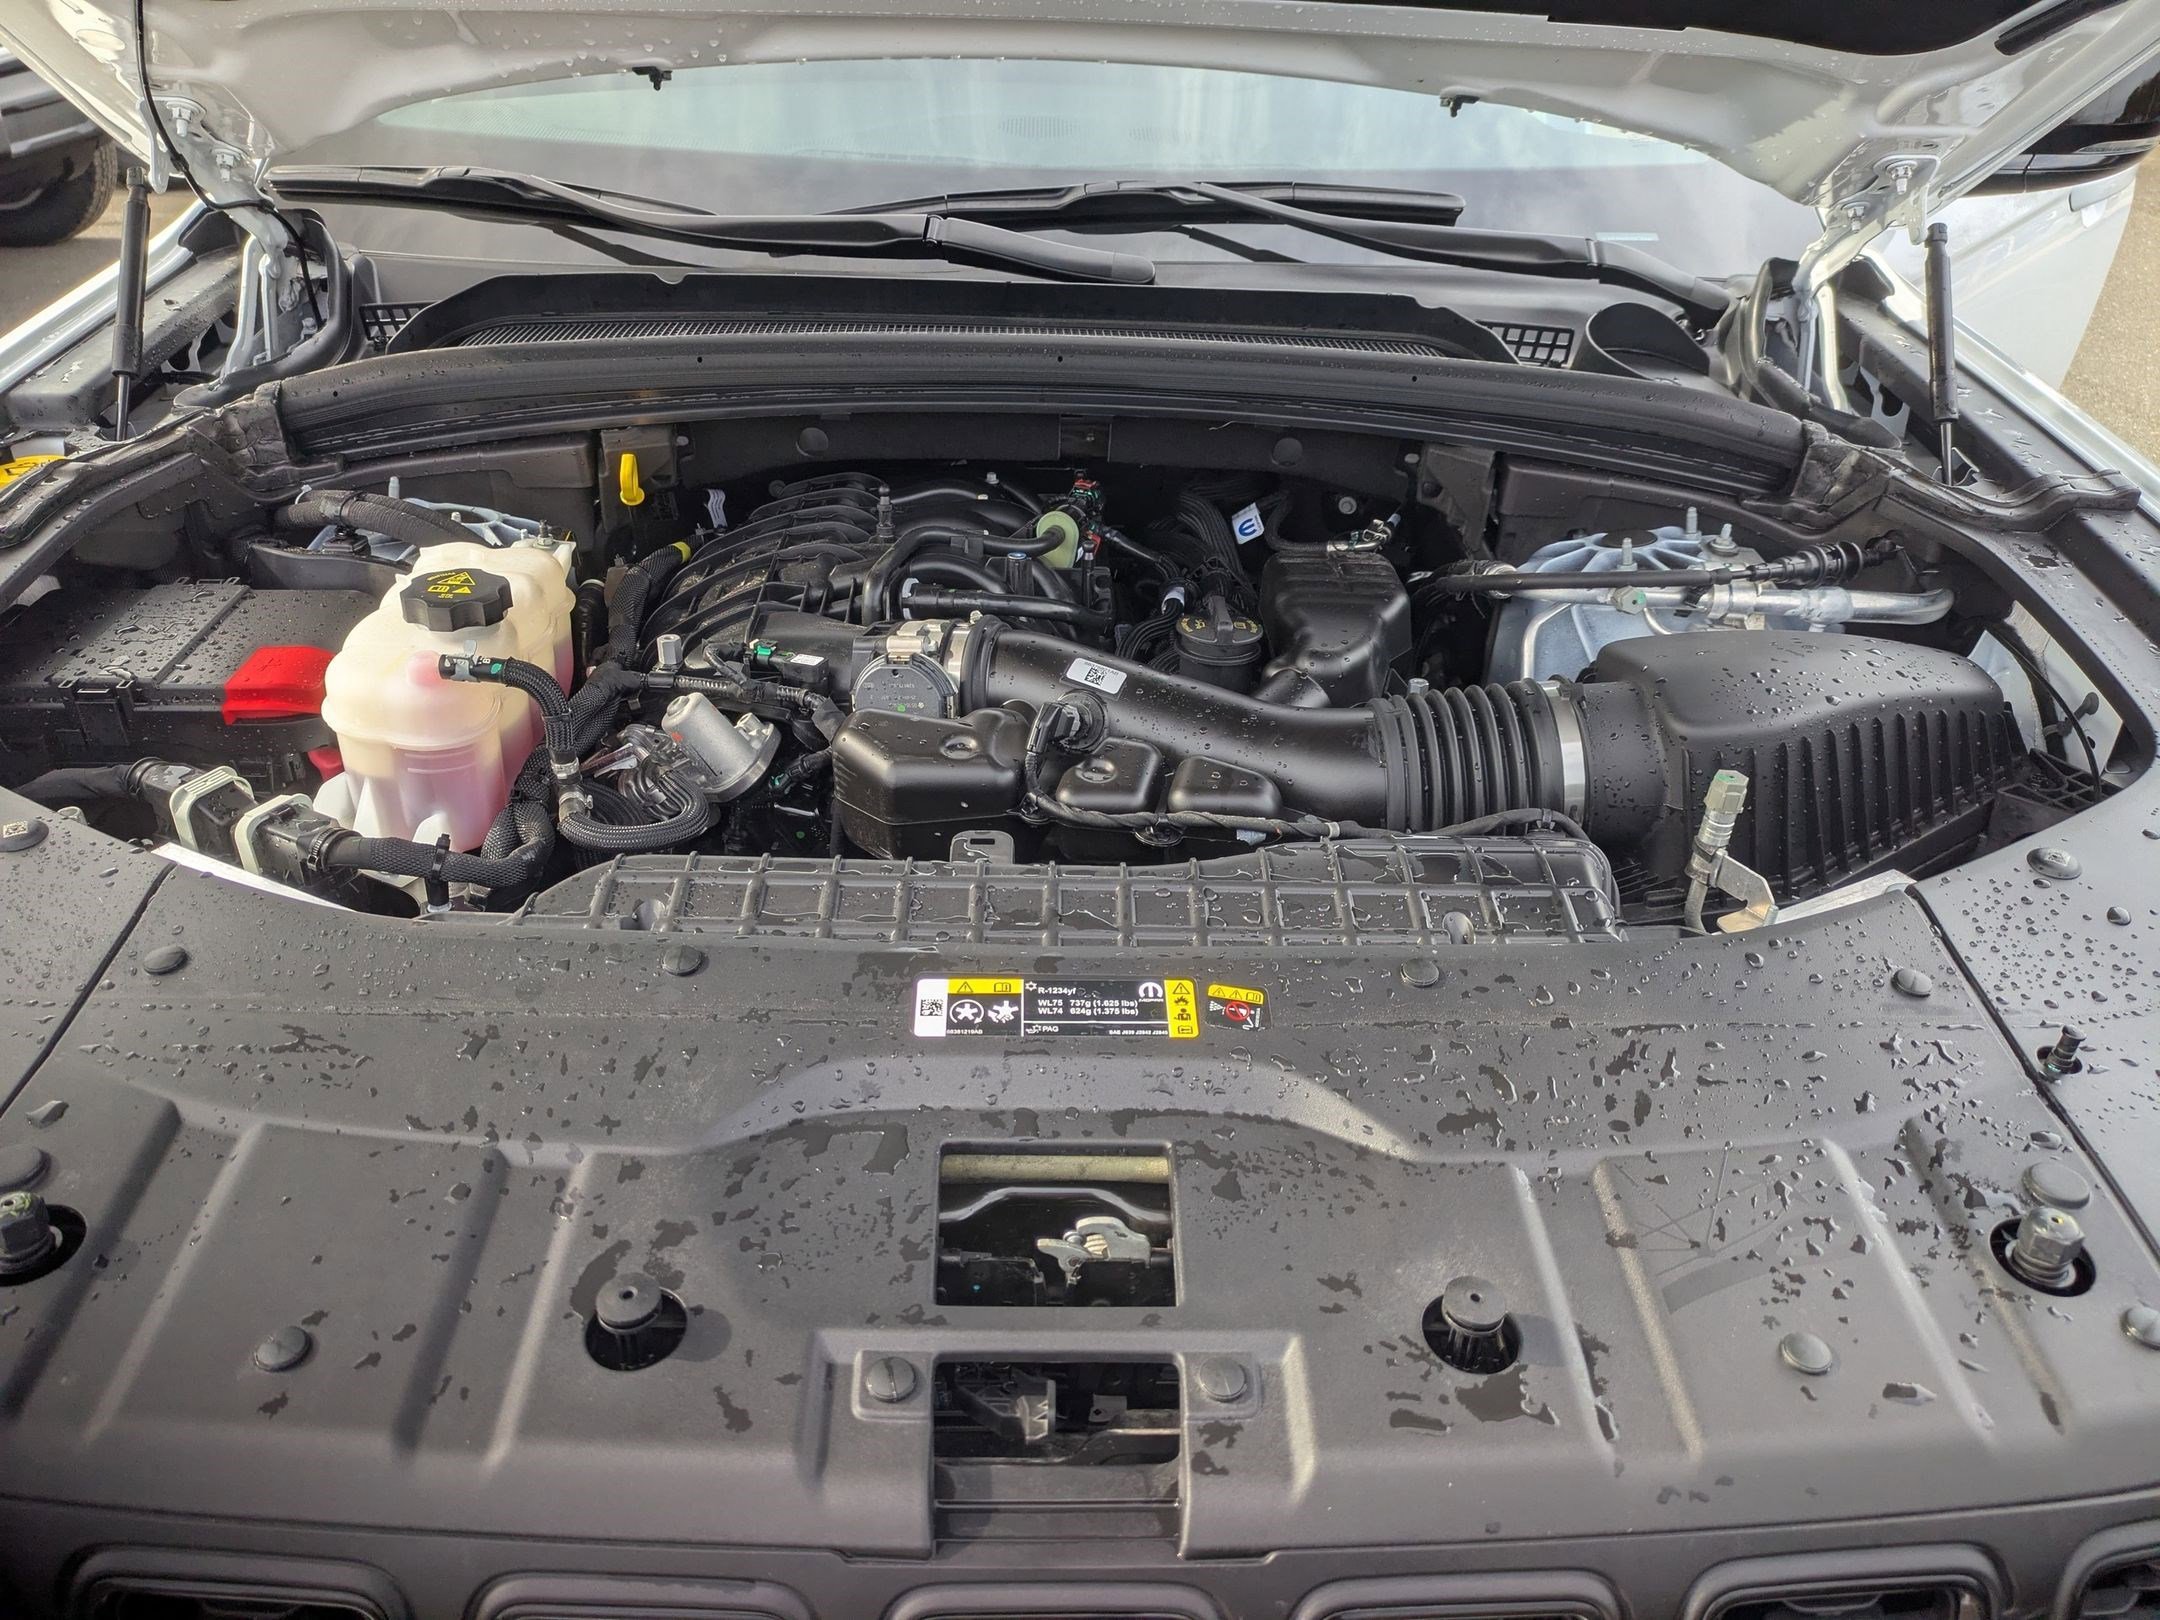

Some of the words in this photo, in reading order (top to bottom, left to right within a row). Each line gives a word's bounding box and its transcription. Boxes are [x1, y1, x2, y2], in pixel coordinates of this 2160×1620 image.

[1038, 987, 1076, 995] R-1234yf
[1038, 999, 1063, 1007] WL75
[1070, 999, 1091, 1008] 737g
[1093, 999, 1119, 1008] (1.625
[1121, 999, 1138, 1008] lbs)
[1038, 1007, 1063, 1015] WL74
[1070, 1007, 1091, 1016] 624g
[1093, 1007, 1120, 1016] (1.375
[1122, 1007, 1139, 1016] lbs)
